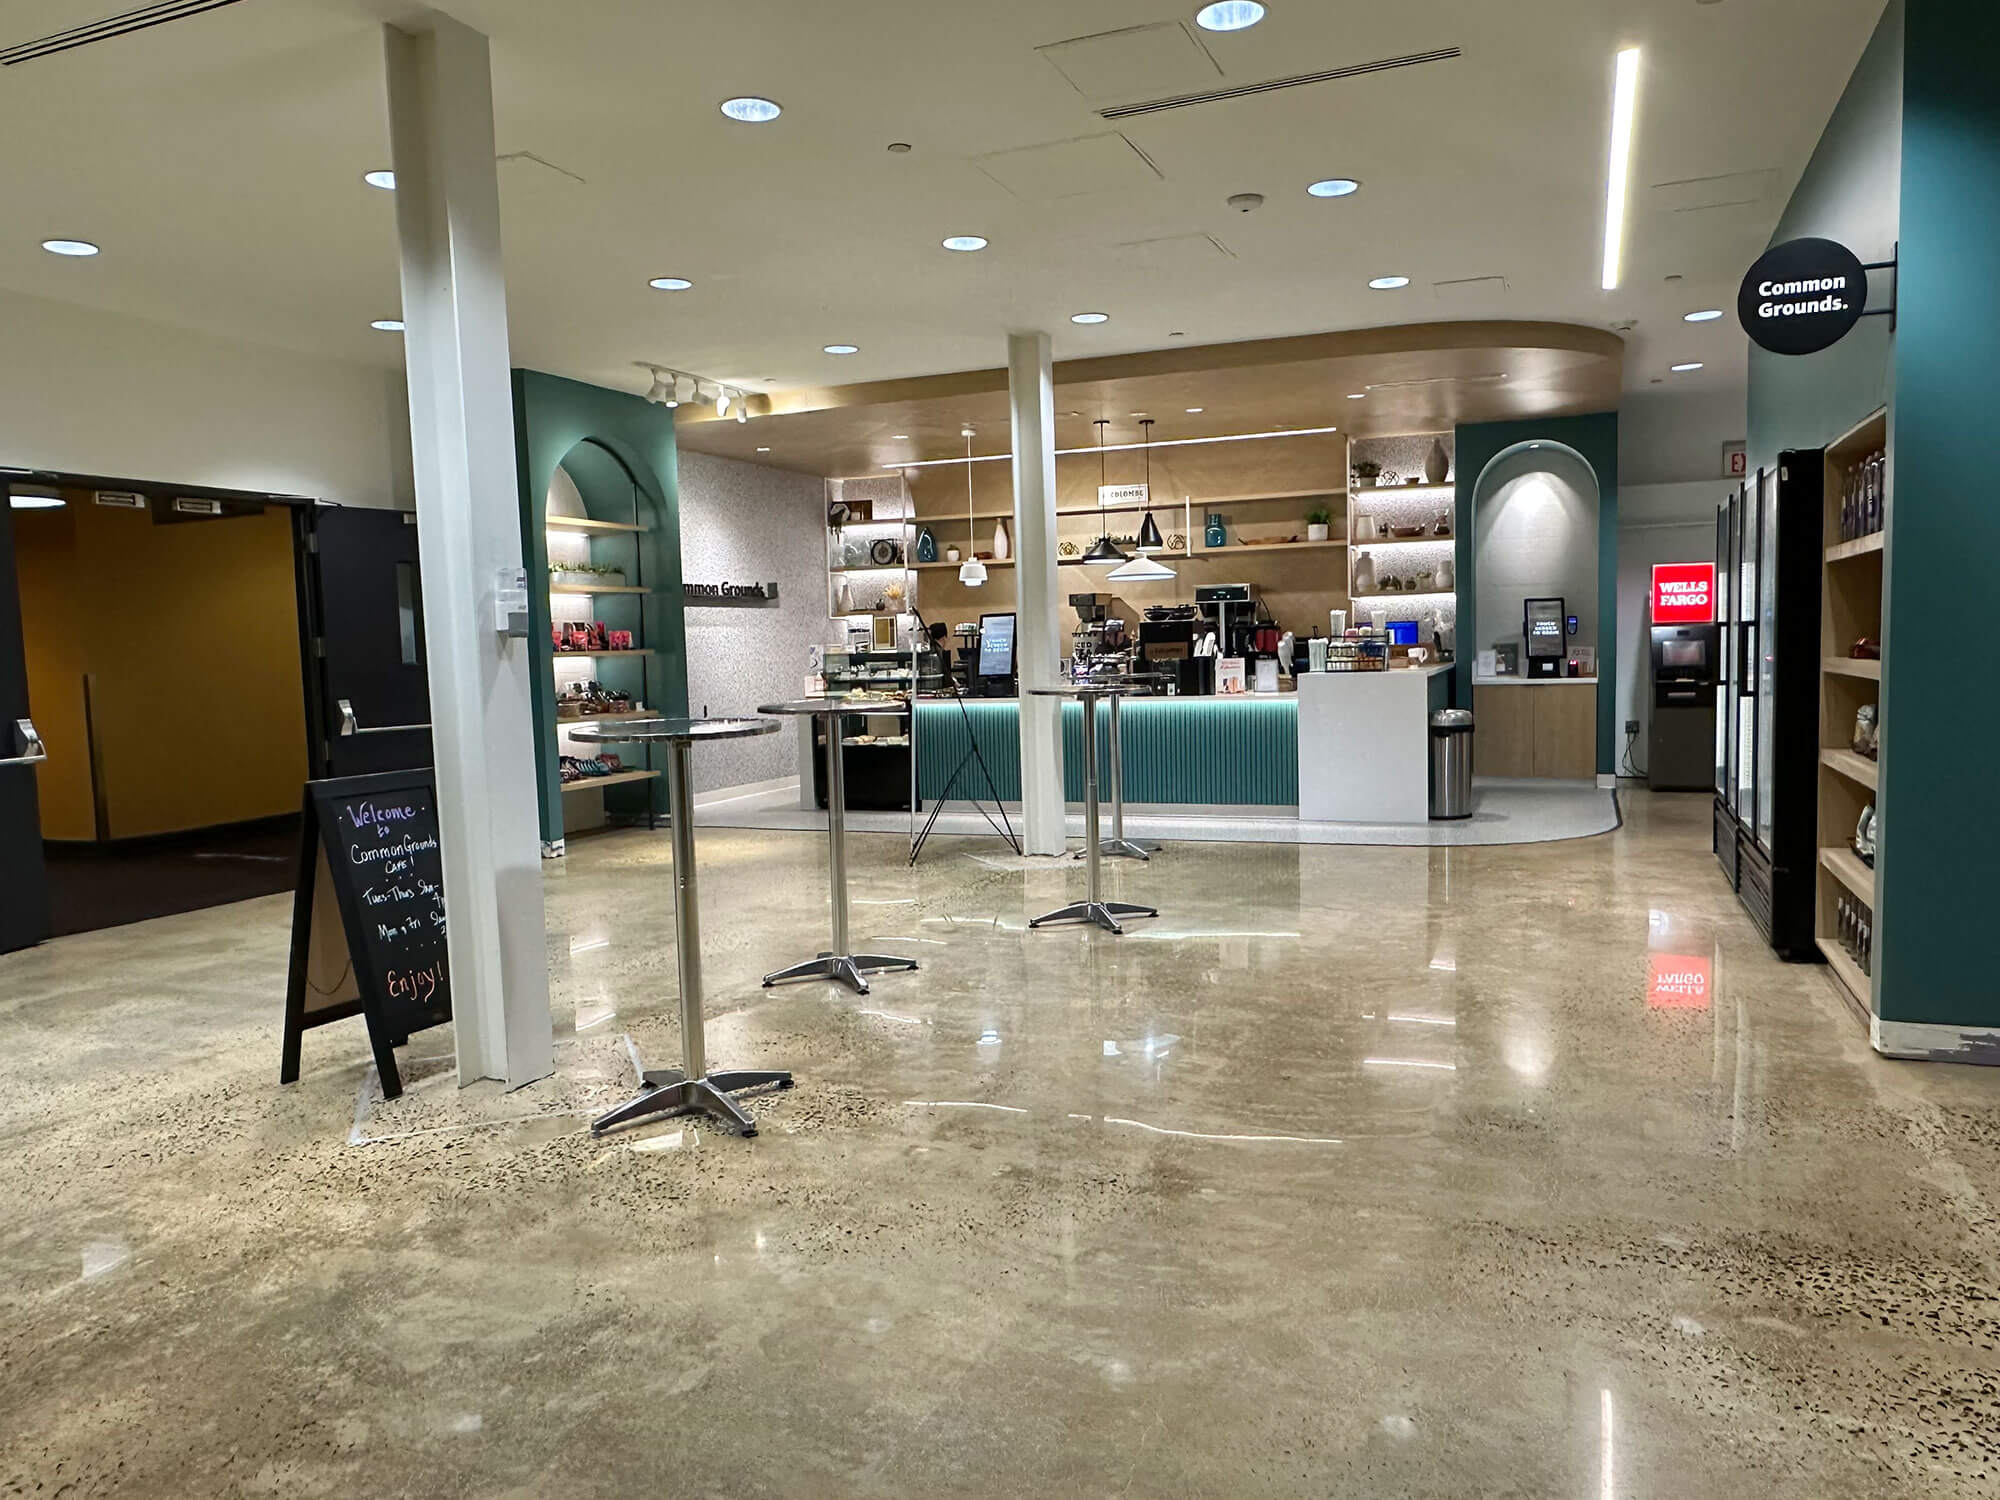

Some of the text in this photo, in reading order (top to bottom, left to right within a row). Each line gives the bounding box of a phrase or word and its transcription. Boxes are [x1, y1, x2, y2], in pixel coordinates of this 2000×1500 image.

[1758, 275, 1846, 297] Common
[1758, 295, 1849, 319] Grounds.
[1658, 581, 1708, 593] WELLS
[1659, 593, 1708, 607] FARGO
[346, 801, 417, 828] Welcome
